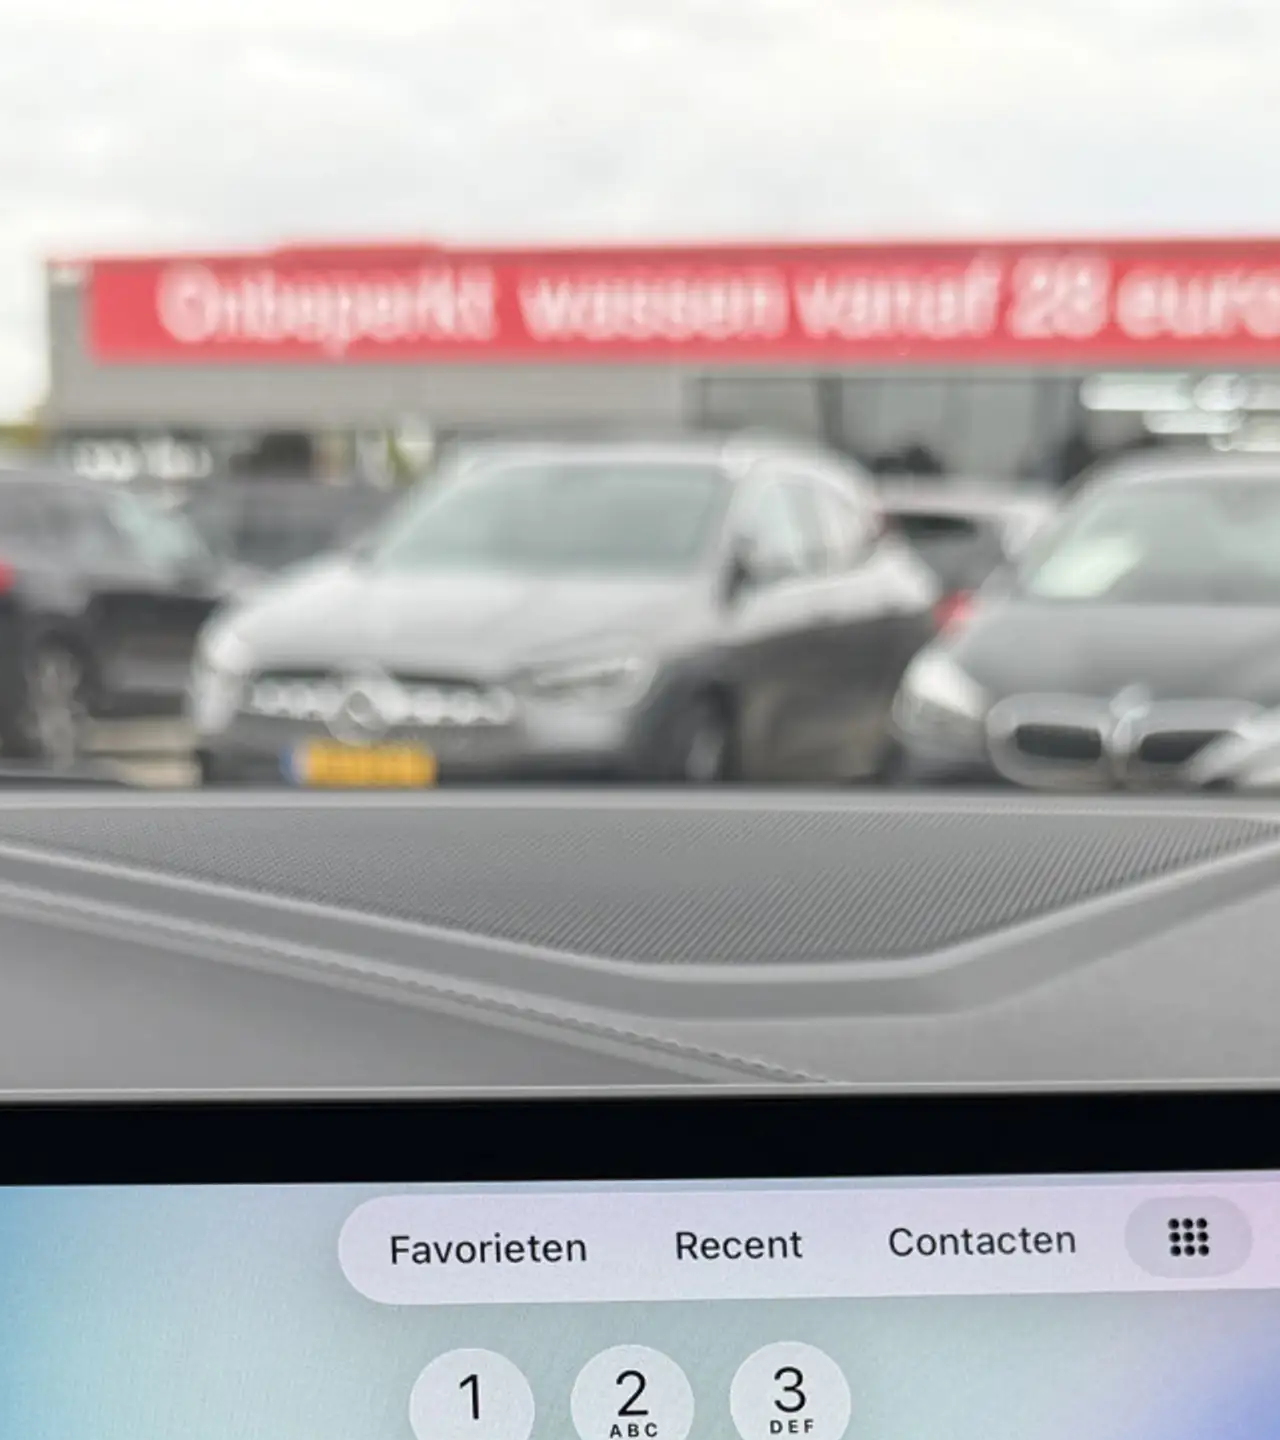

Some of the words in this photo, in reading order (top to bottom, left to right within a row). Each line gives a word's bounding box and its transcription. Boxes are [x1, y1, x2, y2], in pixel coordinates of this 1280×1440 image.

[389, 1230, 588, 1266] Favorieten
[674, 1230, 804, 1262] Recent
[887, 1226, 1077, 1258] Contacten
[458, 1372, 481, 1421] 1
[614, 1368, 650, 1418] 2
[772, 1365, 808, 1415] 3
[608, 1421, 659, 1440] ABC
[768, 1417, 815, 1436] DEF
